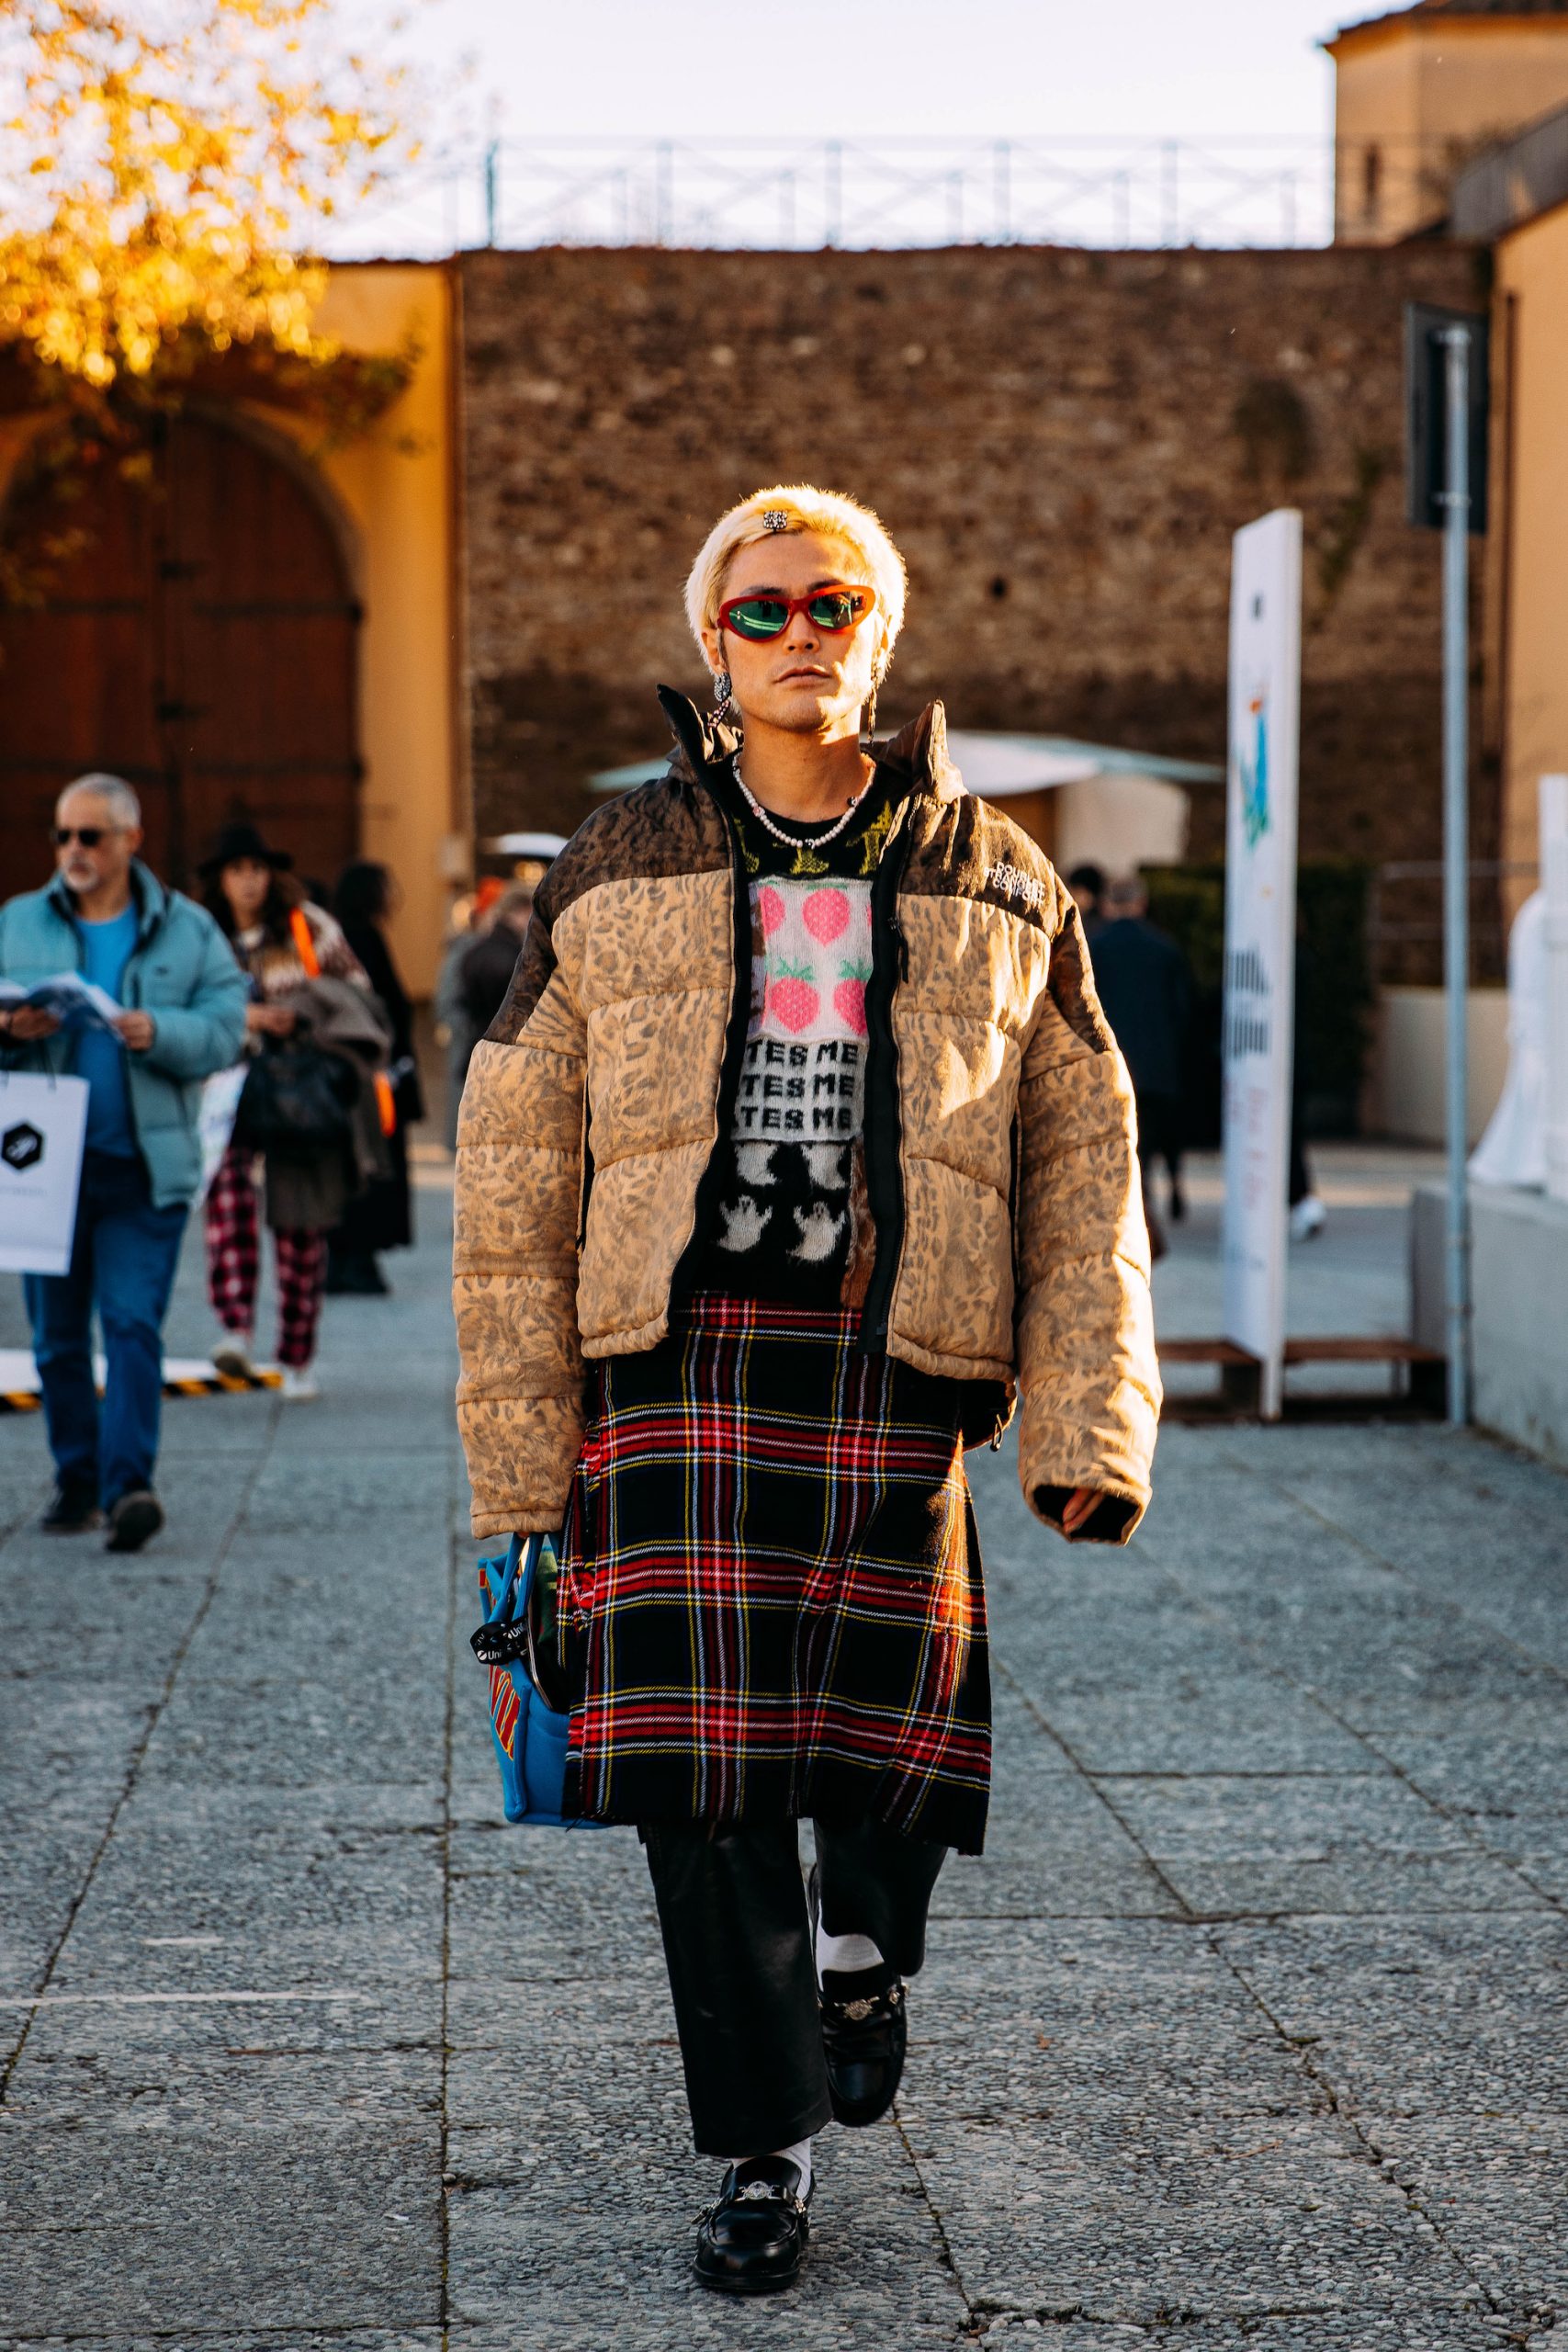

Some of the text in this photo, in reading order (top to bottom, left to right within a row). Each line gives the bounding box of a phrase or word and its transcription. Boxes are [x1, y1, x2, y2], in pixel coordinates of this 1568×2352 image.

[817, 1040, 858, 1064] ME
[813, 1073, 854, 1097] ME
[813, 1106, 852, 1130] ME
